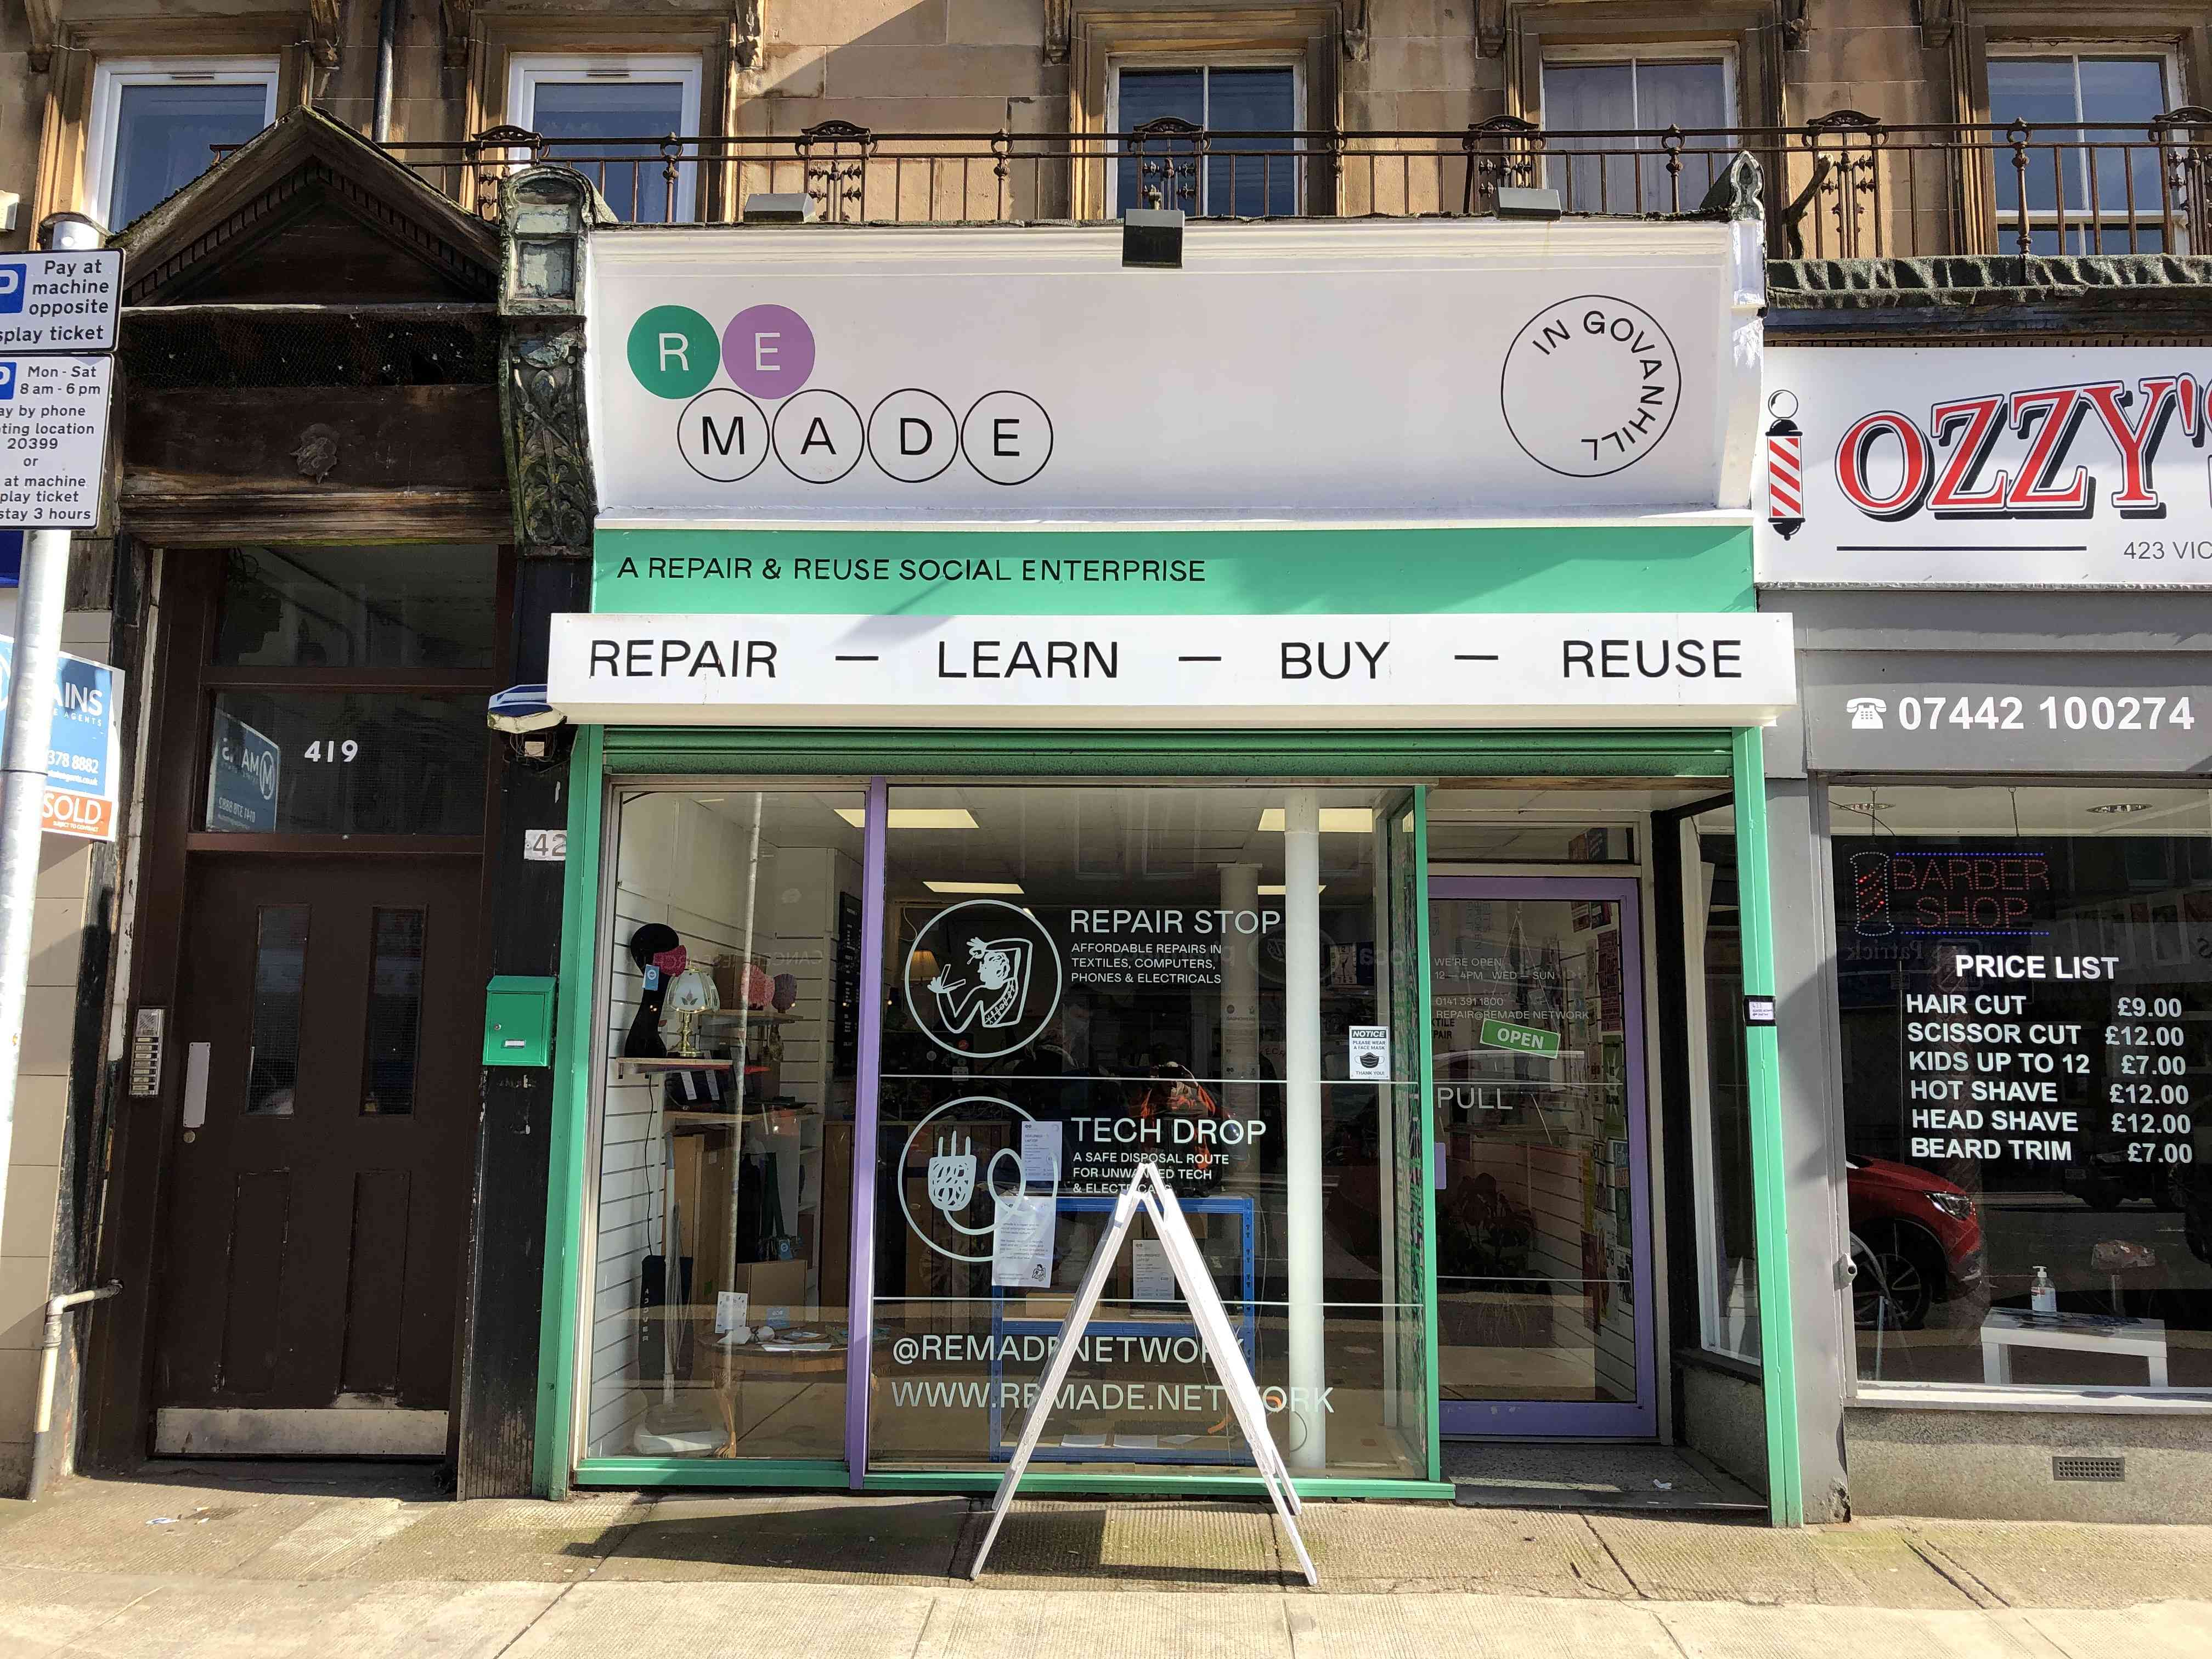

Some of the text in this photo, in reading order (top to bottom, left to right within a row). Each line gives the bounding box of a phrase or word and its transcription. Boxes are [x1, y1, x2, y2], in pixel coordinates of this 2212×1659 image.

[44, 258, 103, 277] Pay at
[32, 279, 109, 295] machine
[29, 298, 109, 318] opposite
[50, 325, 104, 341] ticket
[1532, 319, 1571, 356] IN
[27, 365, 58, 377] Mon
[70, 365, 97, 377] Sat
[20, 383, 29, 394] 8
[32, 385, 53, 394] am
[66, 382, 75, 394] 6
[78, 385, 101, 397] pm
[1581, 310, 1666, 461] GOVANHILL
[19, 405, 36, 419] by
[41, 405, 86, 419] phone
[36, 422, 95, 435] location
[702, 416, 1020, 456] MADE
[7, 437, 59, 450] 20399
[1835, 372, 2212, 522] OZZY'
[23, 457, 39, 467] or
[4, 475, 86, 487] at machine
[36, 490, 79, 503] ticket
[33, 507, 43, 520] 3
[49, 507, 91, 520] hours
[2124, 541, 2165, 560] 423
[617, 557, 1205, 582] A REPAIR & REUSE SOCIAL ENTERPRISE
[590, 640, 777, 678] REPAIR
[938, 641, 1118, 678] LEARN
[1281, 641, 1390, 680] BUY
[1563, 639, 1742, 678] REUSE
[64, 711, 101, 726] AGENTS
[1899, 696, 2194, 730] 07442 100274
[304, 740, 359, 763] 419
[42, 793, 101, 825] SOLD
[1891, 858, 2050, 890] BARBER
[1071, 910, 1280, 934] REPAIR STOP
[1915, 896, 2030, 929] SHOP
[1071, 943, 1222, 954] AFFORDABLE REPAIRS IN
[1071, 958, 1215, 970] TEXTILES, COMPUTERS,
[1434, 957, 1468, 967] WE'RE
[1471, 957, 1503, 967] OPEN
[1955, 954, 2120, 979] PRICE LIST
[1071, 973, 1221, 984] PHONES & ELECTRICALS
[1435, 971, 1445, 980] 12
[1460, 971, 1483, 980] 4PM
[1492, 971, 1517, 980] WED
[1533, 971, 1555, 980] SUN
[1435, 997, 1504, 1006] 0141 391 1800
[1906, 994, 2182, 1018] HAIR CUT £9.00
[1497, 1028, 1544, 1049] OPEN
[1908, 1022, 2184, 1046] SCISSOR CUT £12.00
[1909, 1051, 2186, 1075] KIDS UP TO 12 £7.00
[1437, 1087, 1513, 1109] PULL
[1911, 1080, 2188, 1104] HOT SHAVE £12.00
[1071, 1118, 1266, 1145] TECH DROP
[1912, 1109, 2191, 1134] HEAD SHAVE £12.00
[1073, 1152, 1229, 1164] A SAFE DISPOSAL ROUTE
[1911, 1137, 2192, 1163] BEARD TRIM £7.00
[1073, 1167, 1098, 1178] FOR
[1178, 1169, 1212, 1180] TECH
[1073, 1183, 1082, 1194] &
[891, 1381, 1335, 1414] WWW.REMADE.NETORK
